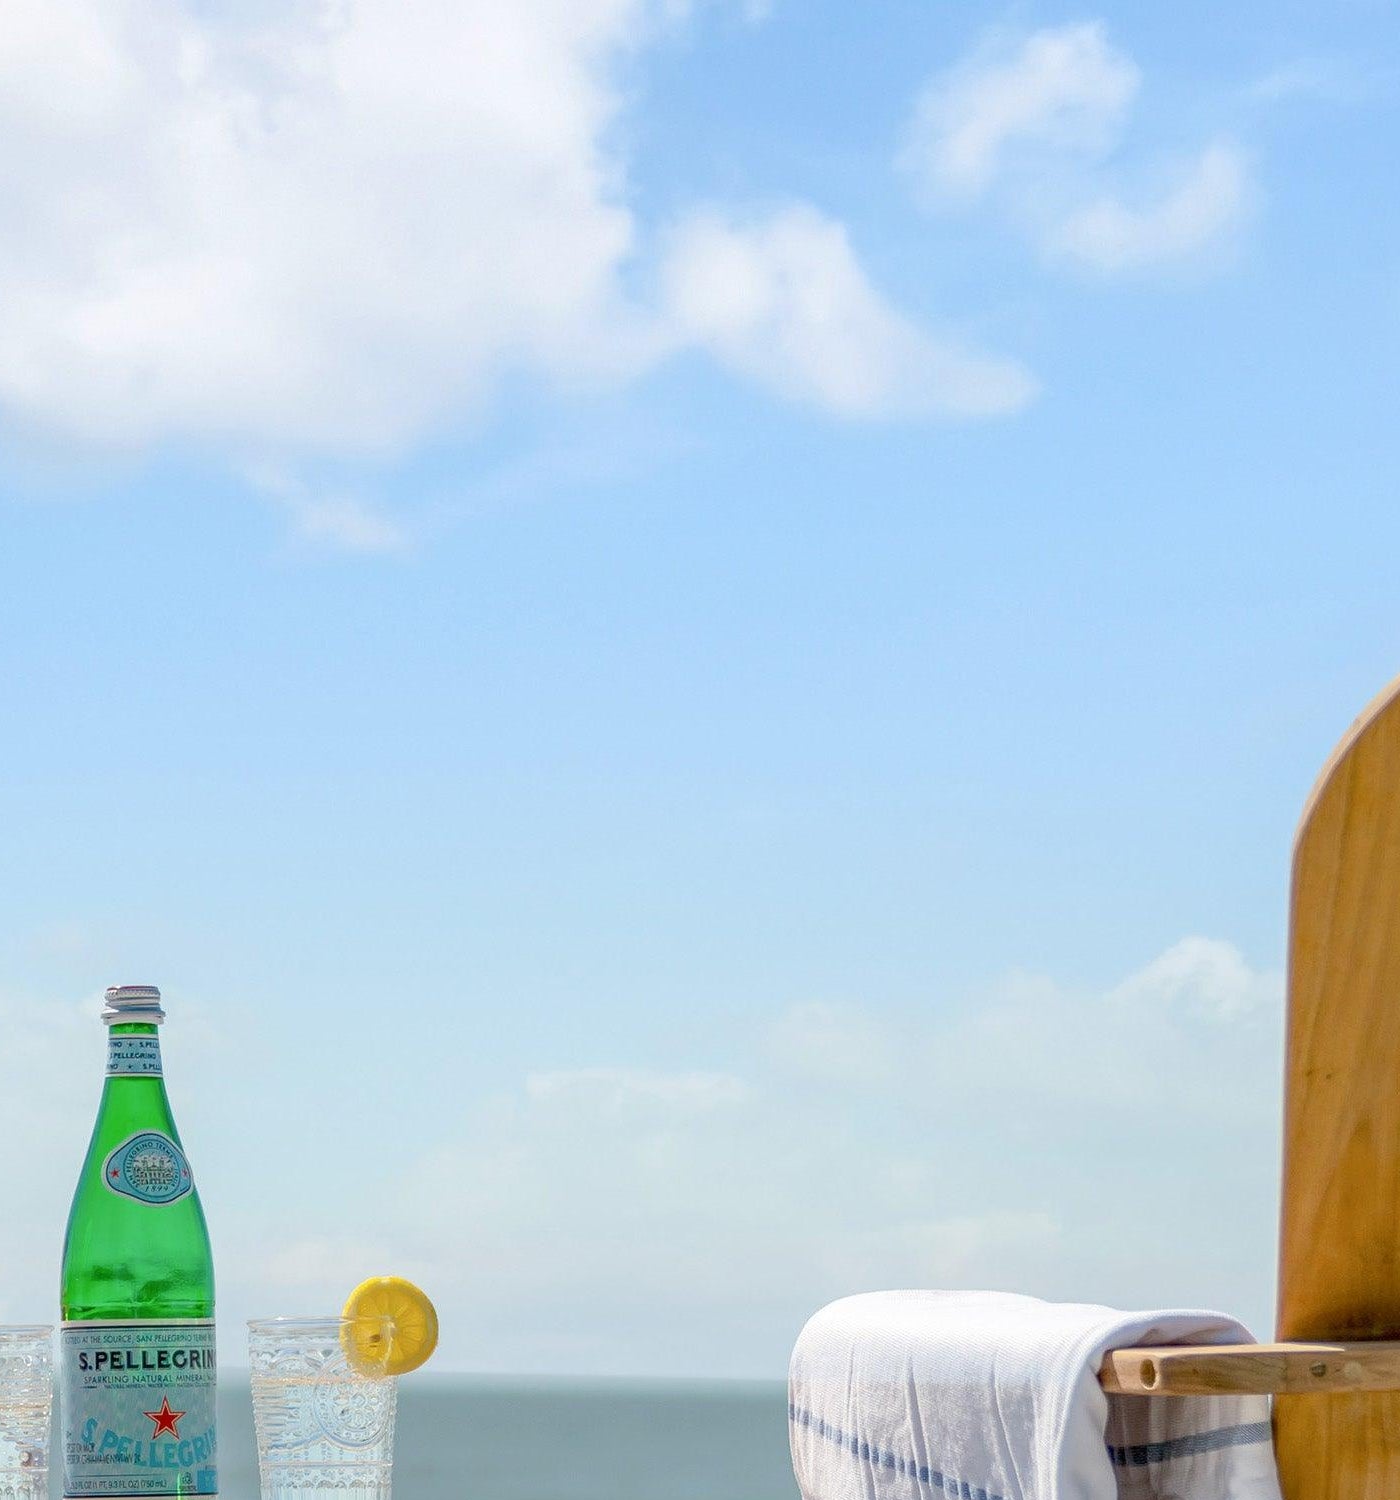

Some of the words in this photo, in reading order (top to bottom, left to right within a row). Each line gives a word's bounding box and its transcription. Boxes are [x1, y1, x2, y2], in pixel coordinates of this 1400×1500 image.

[145, 1185, 169, 1193] 1899
[136, 1335, 152, 1343] SAN
[79, 1350, 217, 1371] S.PELLEGRIN
[84, 1375, 129, 1384] SPARKLING
[132, 1375, 173, 1383] NATURAL
